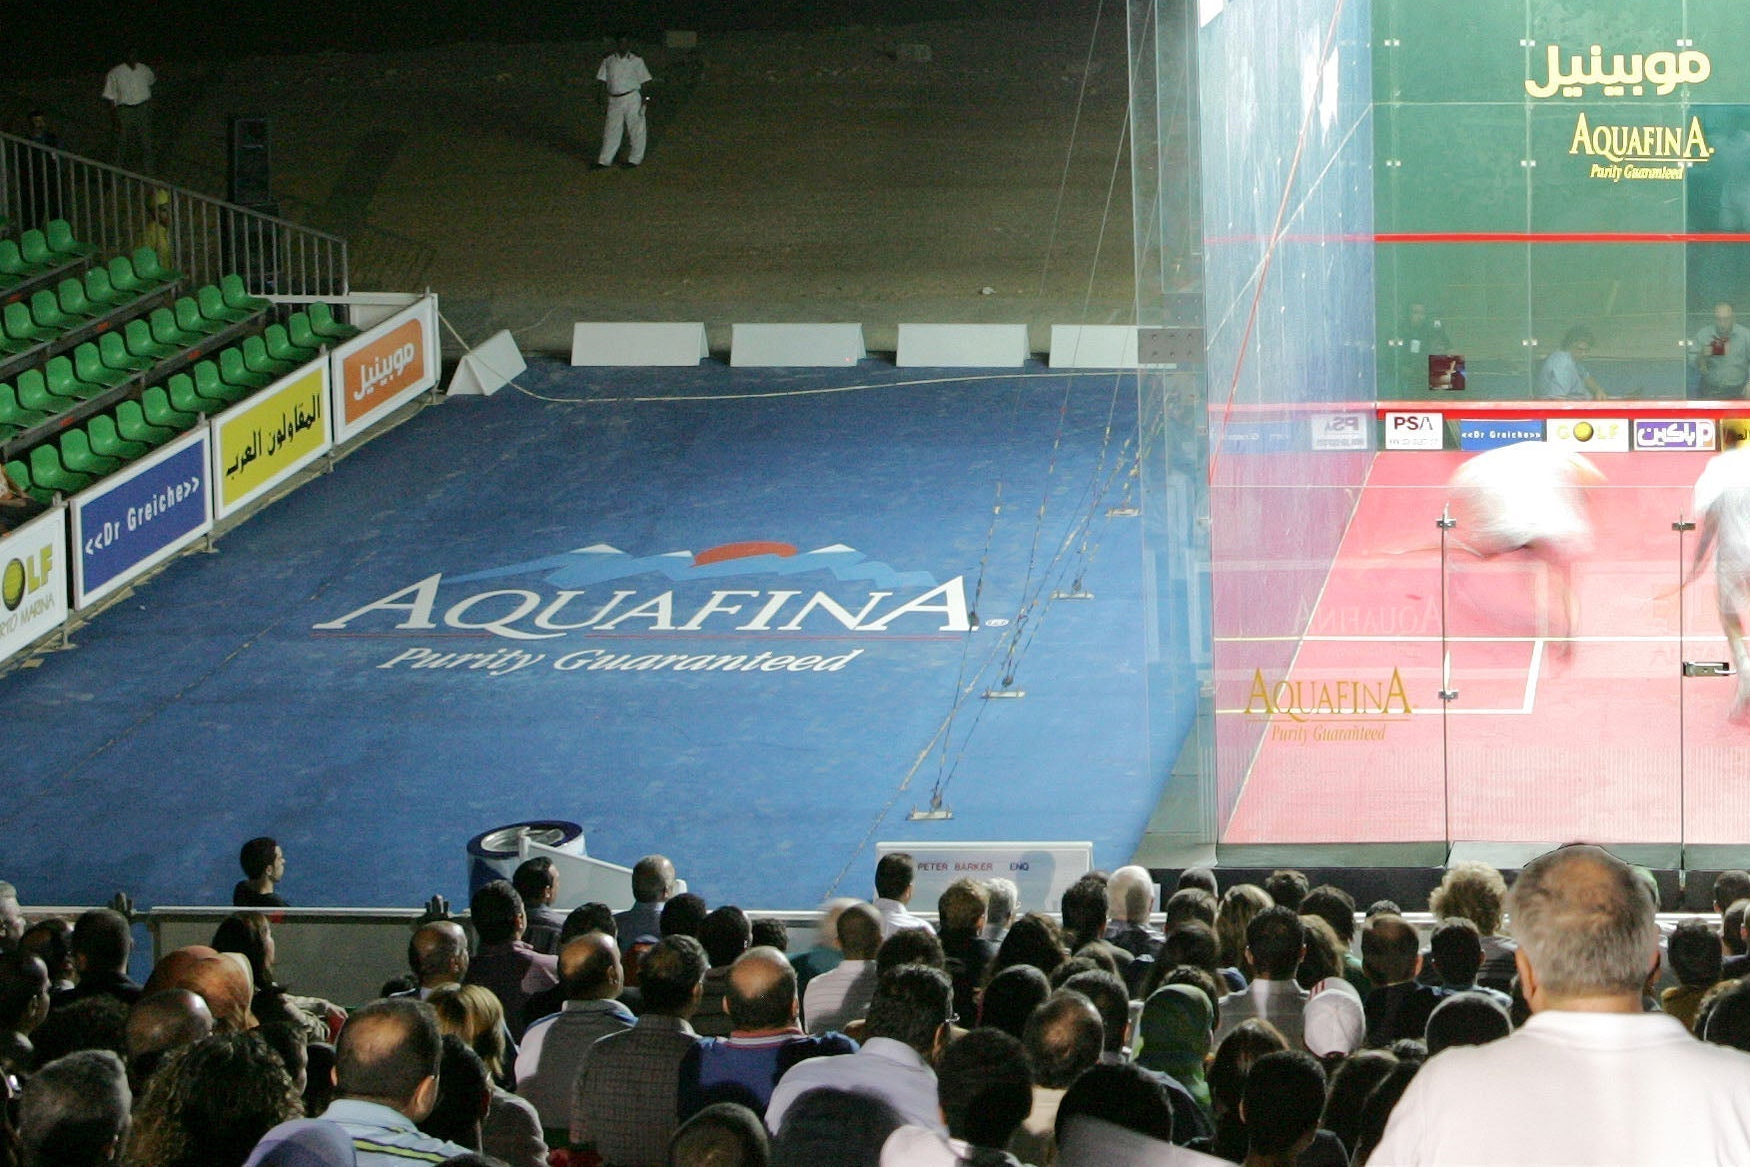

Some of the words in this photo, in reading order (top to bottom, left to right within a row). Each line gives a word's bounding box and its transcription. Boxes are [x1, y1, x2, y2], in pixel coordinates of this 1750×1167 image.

[1525, 44, 1712, 98] موبينيل
[1569, 112, 1712, 163] AQUAFINA
[1590, 163, 1622, 183] Purity
[1624, 163, 1684, 180] Guaranteed
[353, 340, 415, 401] موبينيل
[268, 393, 321, 458] المقاولون
[1394, 416, 1433, 431] PSA
[1557, 421, 1620, 443] GOLF
[1637, 422, 1696, 447] باكين
[225, 426, 263, 480] العرب
[0, 542, 53, 612] OLF
[20, 592, 55, 625] MARINA
[312, 572, 985, 639] AQUAFINA
[377, 647, 547, 676] Purity
[553, 648, 864, 673] Guaranteed
[1243, 666, 1413, 723] AQUAFINA
[1272, 725, 1308, 746] Purity
[1312, 723, 1387, 743] Guaranteed
[917, 862, 948, 872] PETER
[954, 862, 993, 872] BARKER
